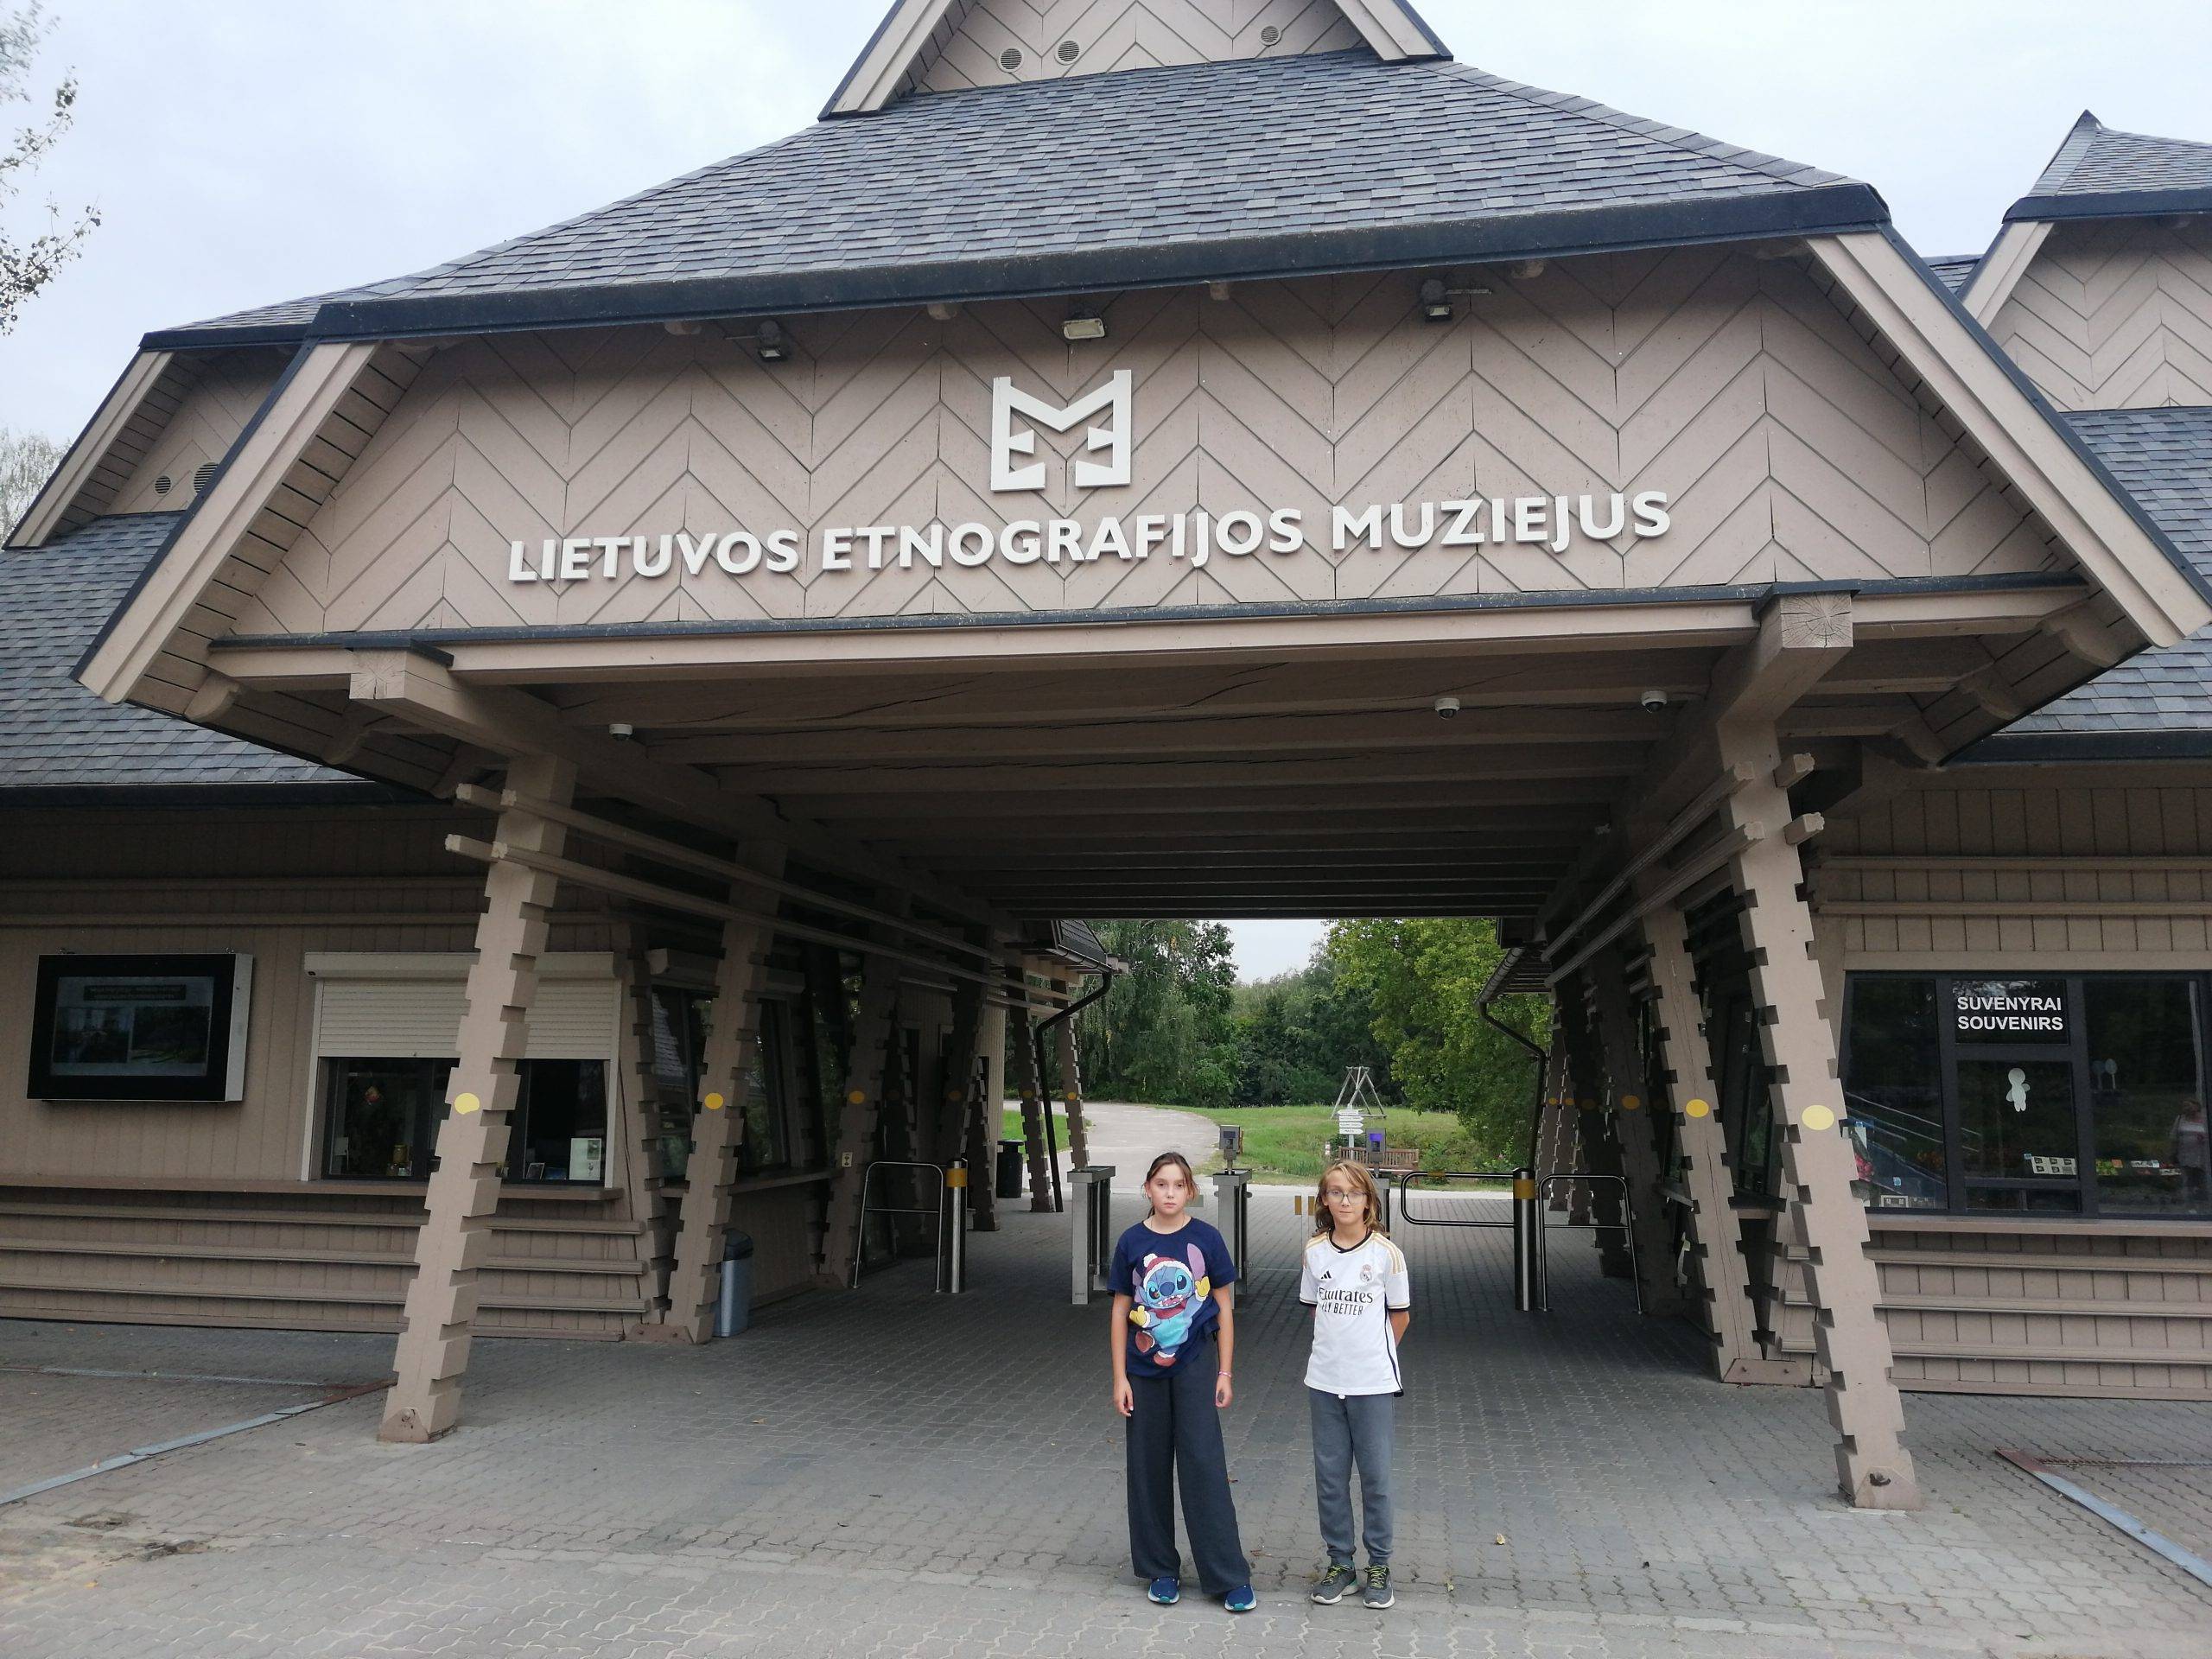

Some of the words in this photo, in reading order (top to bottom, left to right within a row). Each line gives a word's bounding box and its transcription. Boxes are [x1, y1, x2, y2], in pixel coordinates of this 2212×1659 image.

[507, 529, 800, 583] LIETUVOS
[822, 507, 1305, 572] ETNOGRAFIJOS
[1332, 490, 1671, 554] MUZIEJUS
[1957, 996, 2062, 1011] SUVENYRAI
[1958, 1015, 2063, 1030] SOUVENIRS
[1333, 1302, 1363, 1316] BETTER
